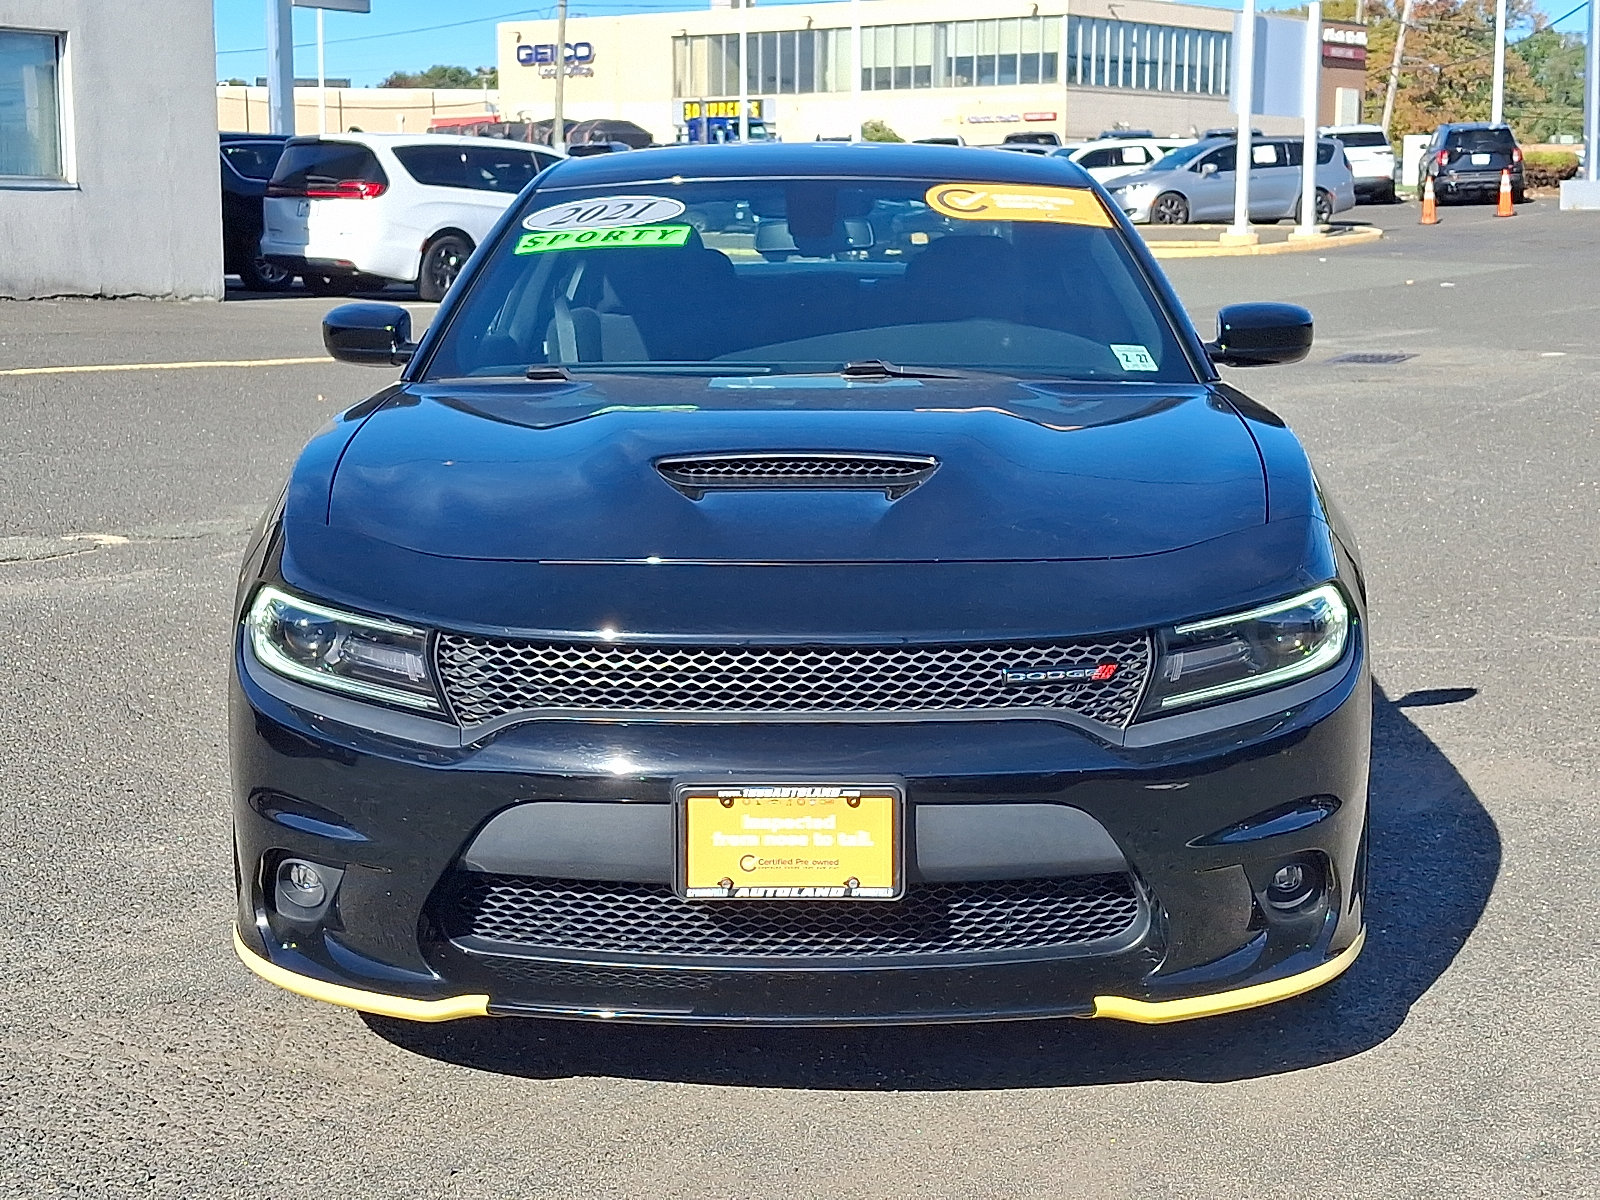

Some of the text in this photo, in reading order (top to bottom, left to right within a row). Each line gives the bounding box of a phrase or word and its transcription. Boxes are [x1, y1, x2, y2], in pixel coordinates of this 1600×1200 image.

[516, 42, 594, 64] GEICO
[547, 201, 658, 226] 2021
[522, 229, 682, 249] SPORTY
[1122, 353, 1149, 363] 2 27
[1007, 668, 1098, 681] DODGE
[742, 814, 837, 832] Inspected
[712, 831, 759, 847] from
[763, 834, 809, 847] nose
[813, 832, 834, 847] to
[758, 858, 793, 866] Certified
[734, 887, 845, 898] AUTOLAND
